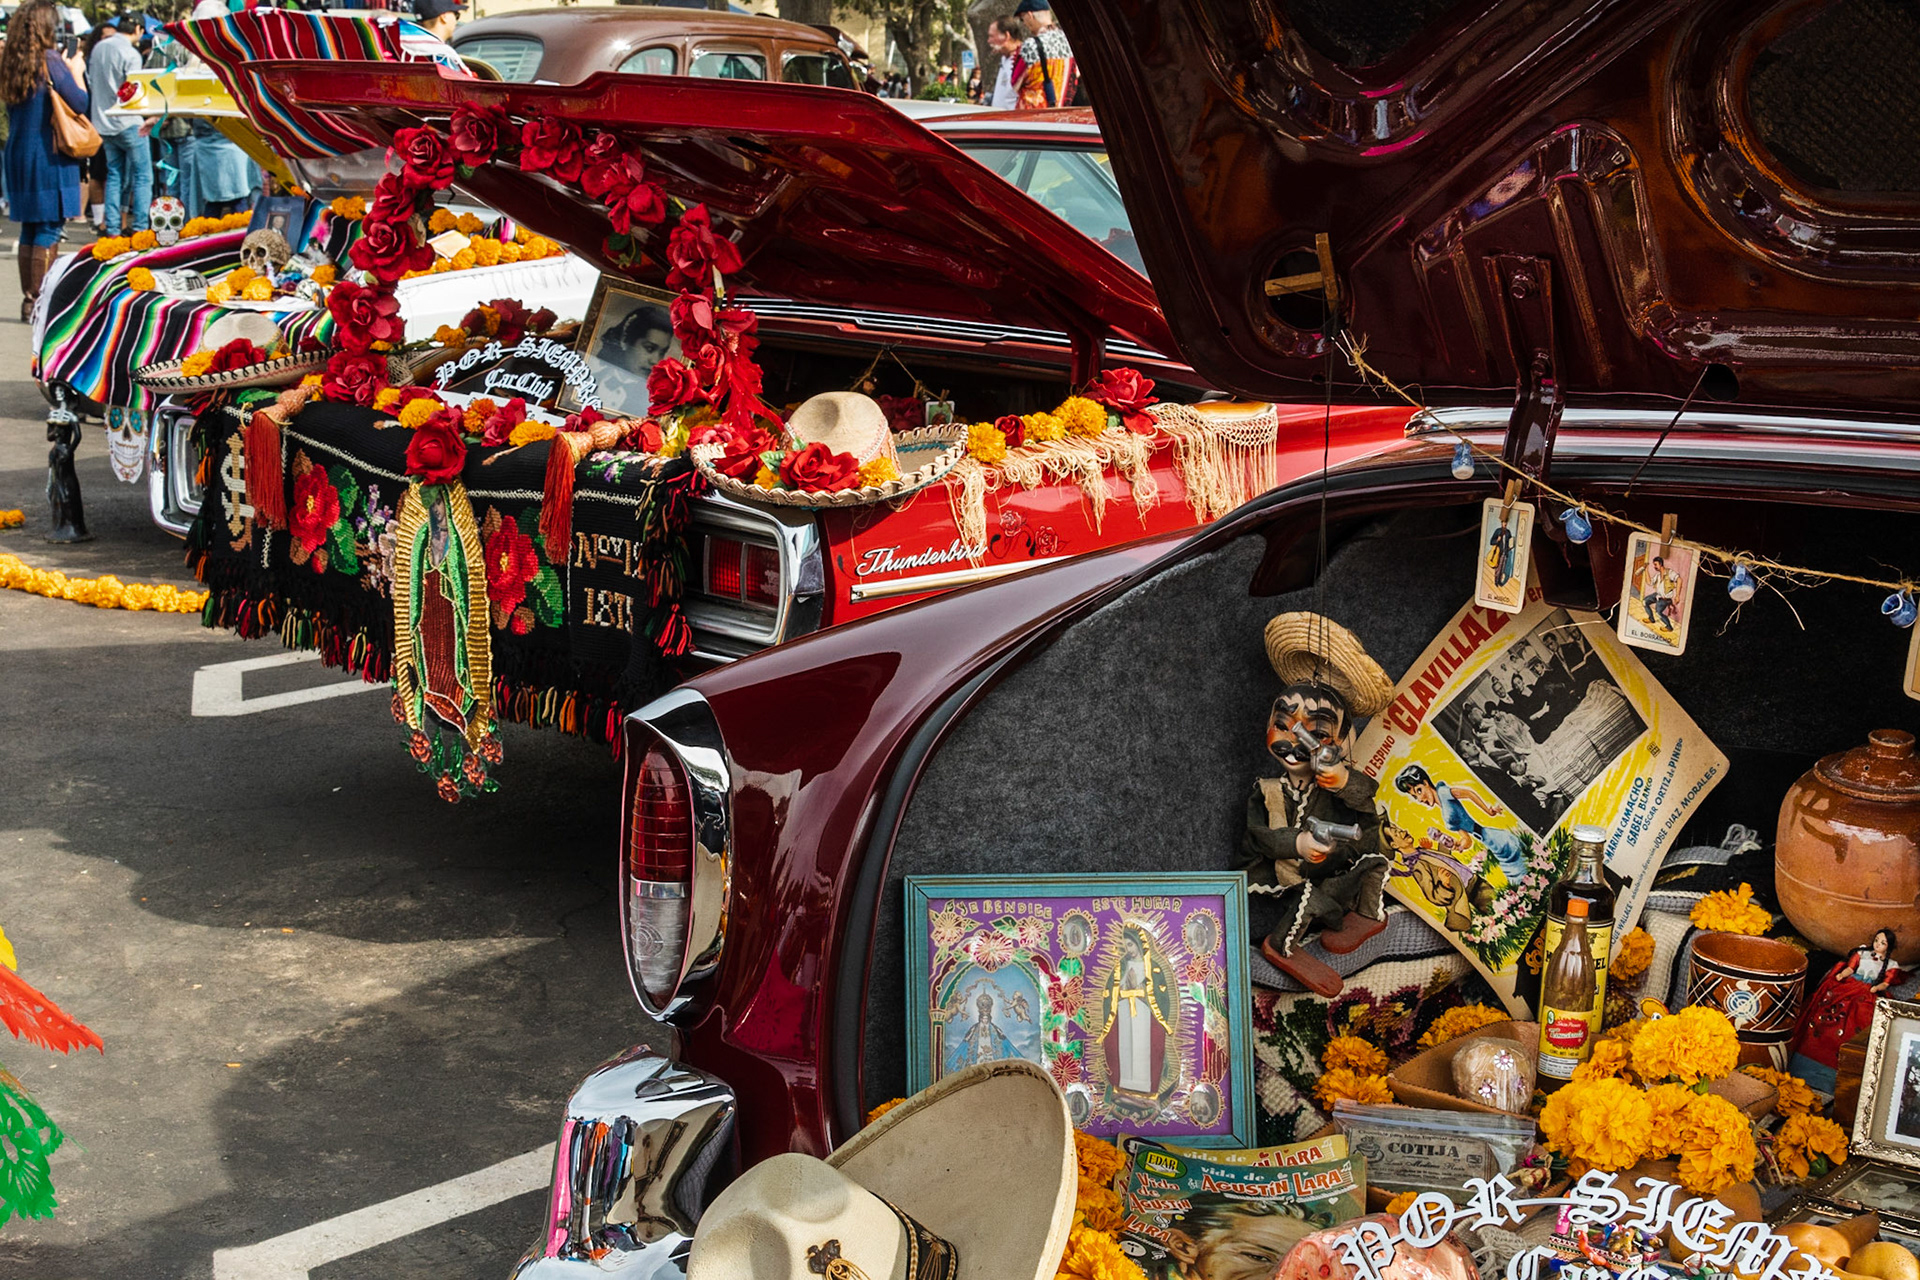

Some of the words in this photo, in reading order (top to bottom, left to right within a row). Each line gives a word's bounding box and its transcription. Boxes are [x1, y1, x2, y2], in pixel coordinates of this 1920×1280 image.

[435, 340, 503, 386] POR
[514, 337, 602, 411] SIEMPRE
[485, 369, 517, 388] Car
[516, 371, 554, 400] Club
[856, 538, 988, 577] Thunderbird
[1369, 735, 1395, 770] ESPINO
[1604, 829, 1624, 860] MARINA
[1620, 777, 1644, 828] CAMACHO
[1626, 813, 1643, 847] ISABEL
[1638, 777, 1653, 810] BLANCO
[1641, 806, 1658, 831] OSCAR
[1654, 776, 1671, 806] ORTIZ
[1654, 828, 1668, 849] JOSE
[1665, 808, 1683, 829] DIAZ
[1680, 766, 1717, 809] MORALES
[1148, 1153, 1176, 1170] EDAR
[1183, 1151, 1218, 1162] vida
[1225, 1153, 1247, 1162] de
[1387, 1142, 1460, 1158] COTIJA
[1135, 1172, 1180, 1190] Vida
[1137, 1185, 1161, 1197] de
[1200, 1166, 1236, 1179] vida
[1243, 1172, 1265, 1181] de
[1292, 1168, 1344, 1197] LARA
[1124, 1213, 1171, 1242] LARA
[1332, 1172, 1527, 1280] POR
